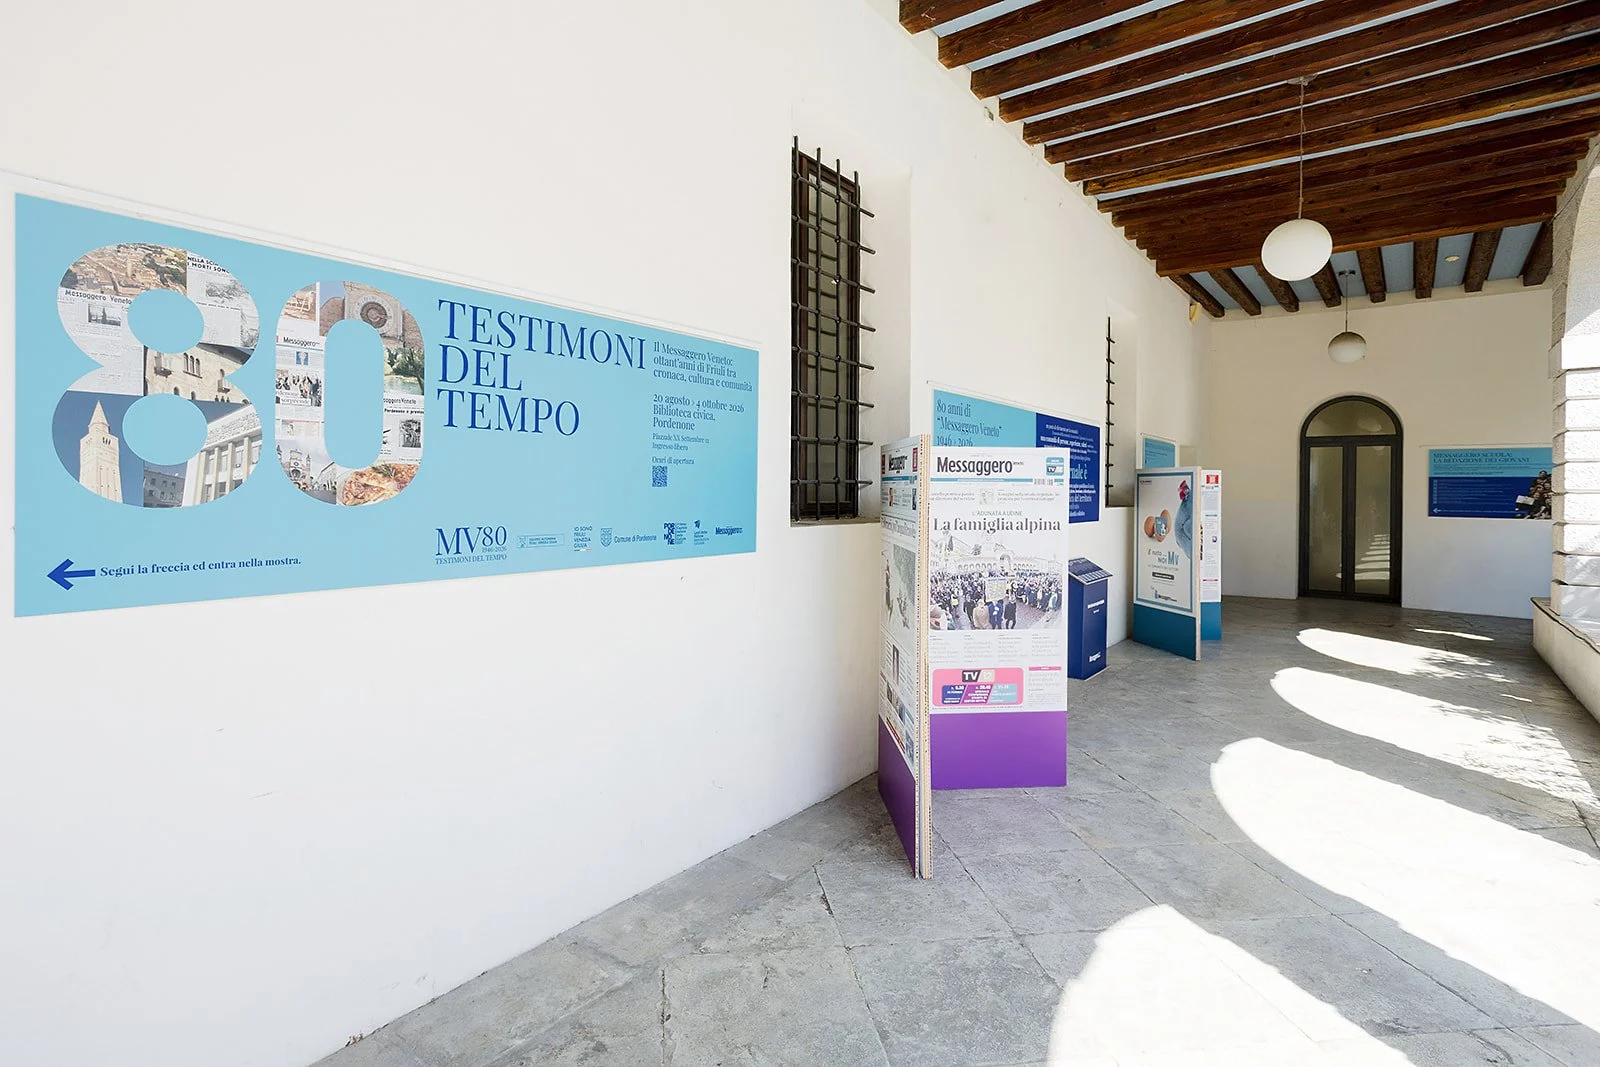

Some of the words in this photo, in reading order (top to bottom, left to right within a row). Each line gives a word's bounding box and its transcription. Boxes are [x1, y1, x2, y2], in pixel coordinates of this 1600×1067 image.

[438, 299, 646, 369] TESTIMONI
[654, 341, 660, 352] Il
[662, 343, 706, 359] Messaggero
[707, 352, 733, 366] Veneto:
[52, 243, 425, 508] 80
[438, 344, 522, 391] DEL
[697, 362, 705, 372] di
[706, 363, 726, 377] Friuli
[726, 368, 736, 378] tra
[653, 368, 687, 382] cronaca,
[688, 373, 714, 386] cultura
[715, 379, 720, 387] e
[721, 381, 752, 392] comunità
[437, 388, 580, 436] TEMPO
[653, 394, 663, 402] 20
[665, 395, 690, 406] agosto
[696, 400, 701, 408] 4
[702, 399, 728, 411] ottobre
[729, 403, 745, 413] 2026
[653, 404, 691, 419] Biblioteca
[937, 399, 946, 413] 80
[948, 403, 963, 416] anni
[964, 404, 971, 417] di
[653, 417, 695, 430] Pordenone
[937, 457, 1013, 476] Messaggero
[934, 518, 951, 531] La
[954, 518, 1013, 534] famiglia
[1015, 518, 1061, 533] alpina
[614, 536, 631, 544] Comune
[636, 534, 657, 542] Pordenone
[100, 565, 135, 578] Segui
[137, 564, 148, 575] la
[151, 562, 190, 574] freccia
[192, 561, 205, 572] ed
[208, 560, 236, 570] entra
[238, 558, 263, 568] nella
[265, 557, 302, 566] mostra.
[435, 556, 472, 565] TESTIMONI
[964, 672, 978, 680] TV
